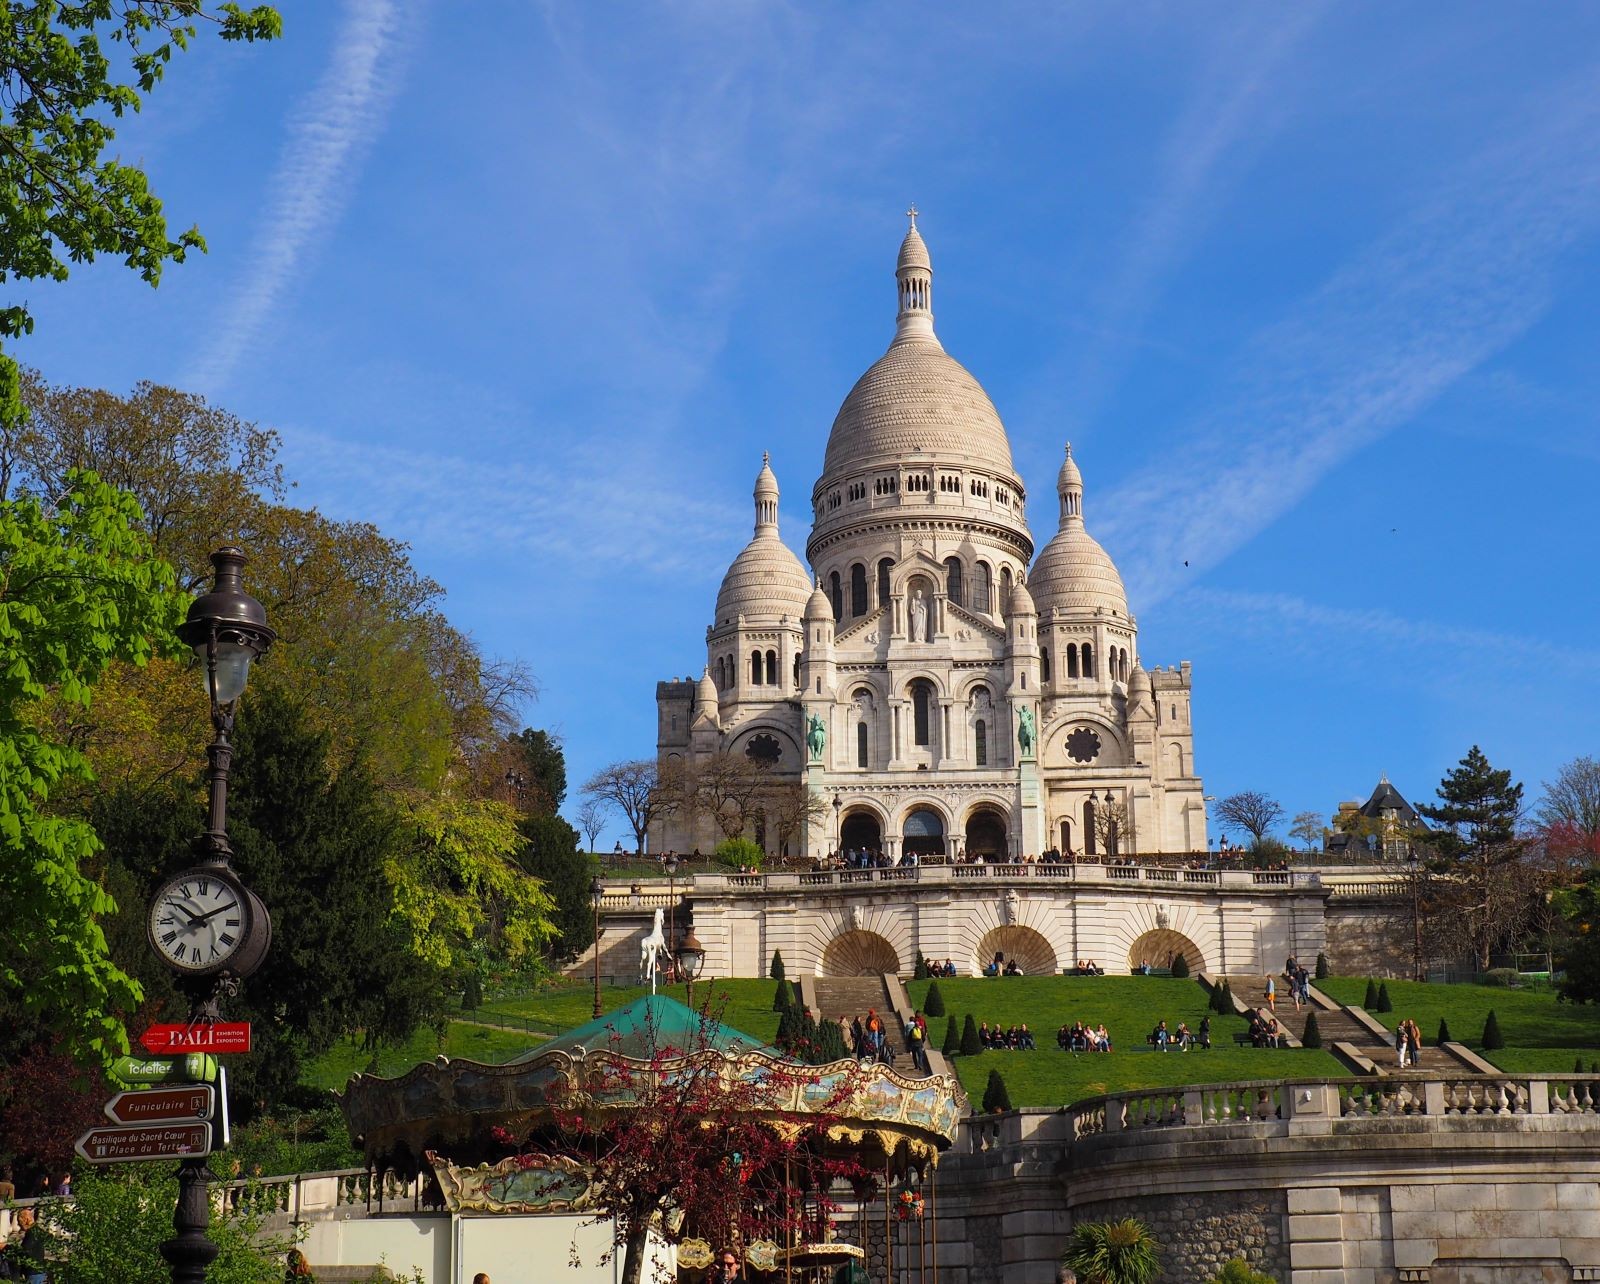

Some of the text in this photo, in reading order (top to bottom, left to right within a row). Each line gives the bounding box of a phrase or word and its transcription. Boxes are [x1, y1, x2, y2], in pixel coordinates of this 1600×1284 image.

[197, 882, 208, 896] XII
[169, 1026, 214, 1045] DALÍ
[129, 1062, 173, 1074] toilettes
[129, 1101, 184, 1112] Funiculaire
[92, 1131, 186, 1145] Basilique du Sacré Cœur
[109, 1145, 135, 1154] Place
[140, 1144, 152, 1152] du
